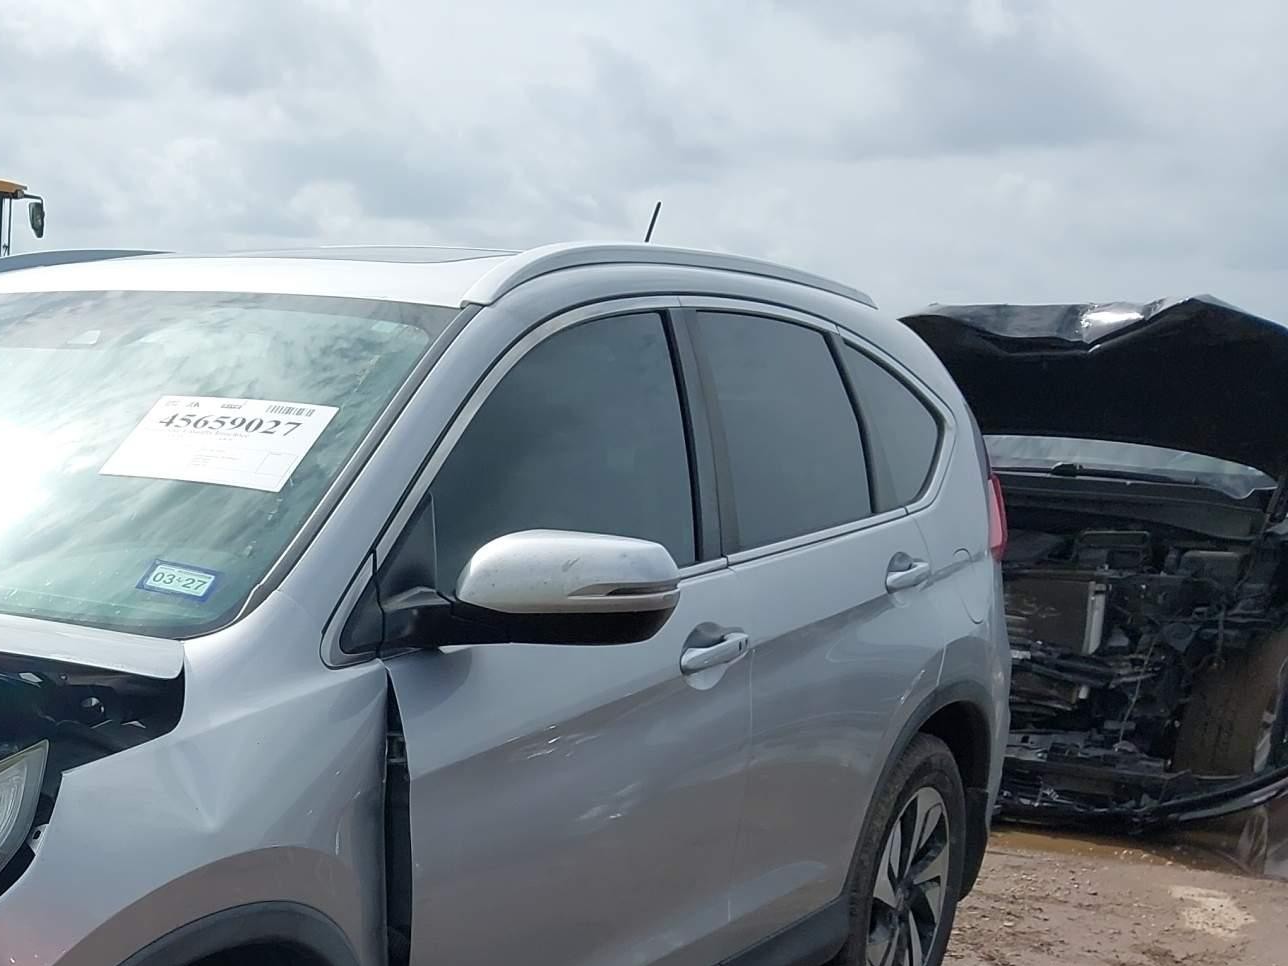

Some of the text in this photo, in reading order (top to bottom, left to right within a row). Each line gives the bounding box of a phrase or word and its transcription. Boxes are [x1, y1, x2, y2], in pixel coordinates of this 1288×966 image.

[159, 412, 303, 437] 45659027
[152, 571, 208, 591] 03 27
